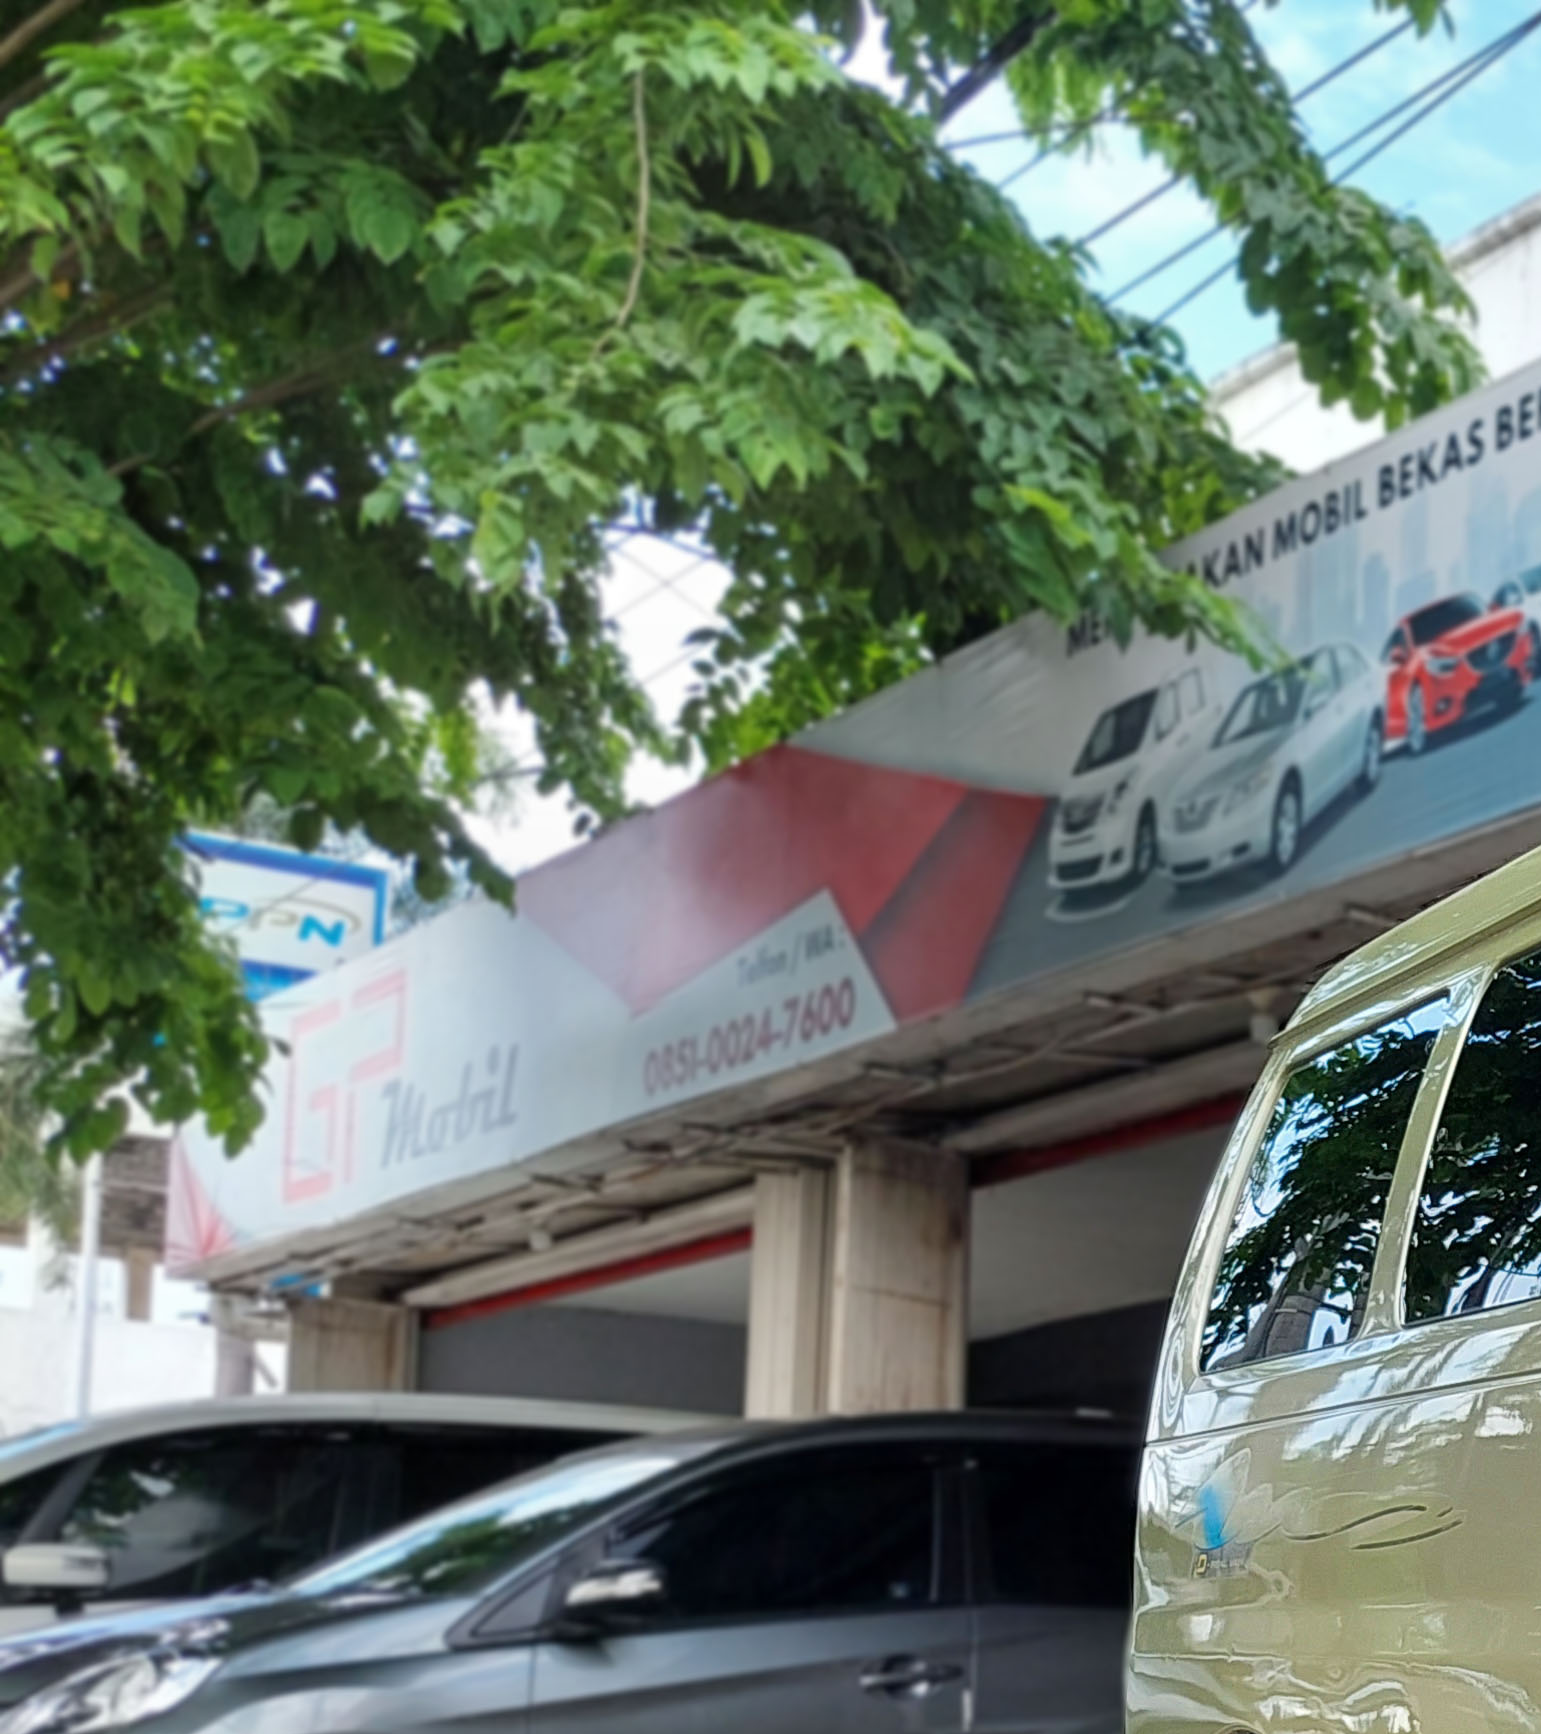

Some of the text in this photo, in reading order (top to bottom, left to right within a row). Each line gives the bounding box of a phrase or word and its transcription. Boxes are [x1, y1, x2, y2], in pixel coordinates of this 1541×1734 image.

[1272, 478, 1369, 562] MOBIL
[1377, 416, 1487, 510] BEKAS
[642, 975, 857, 1098] 0851-0024-7600
[379, 1041, 521, 1172] Mobil
